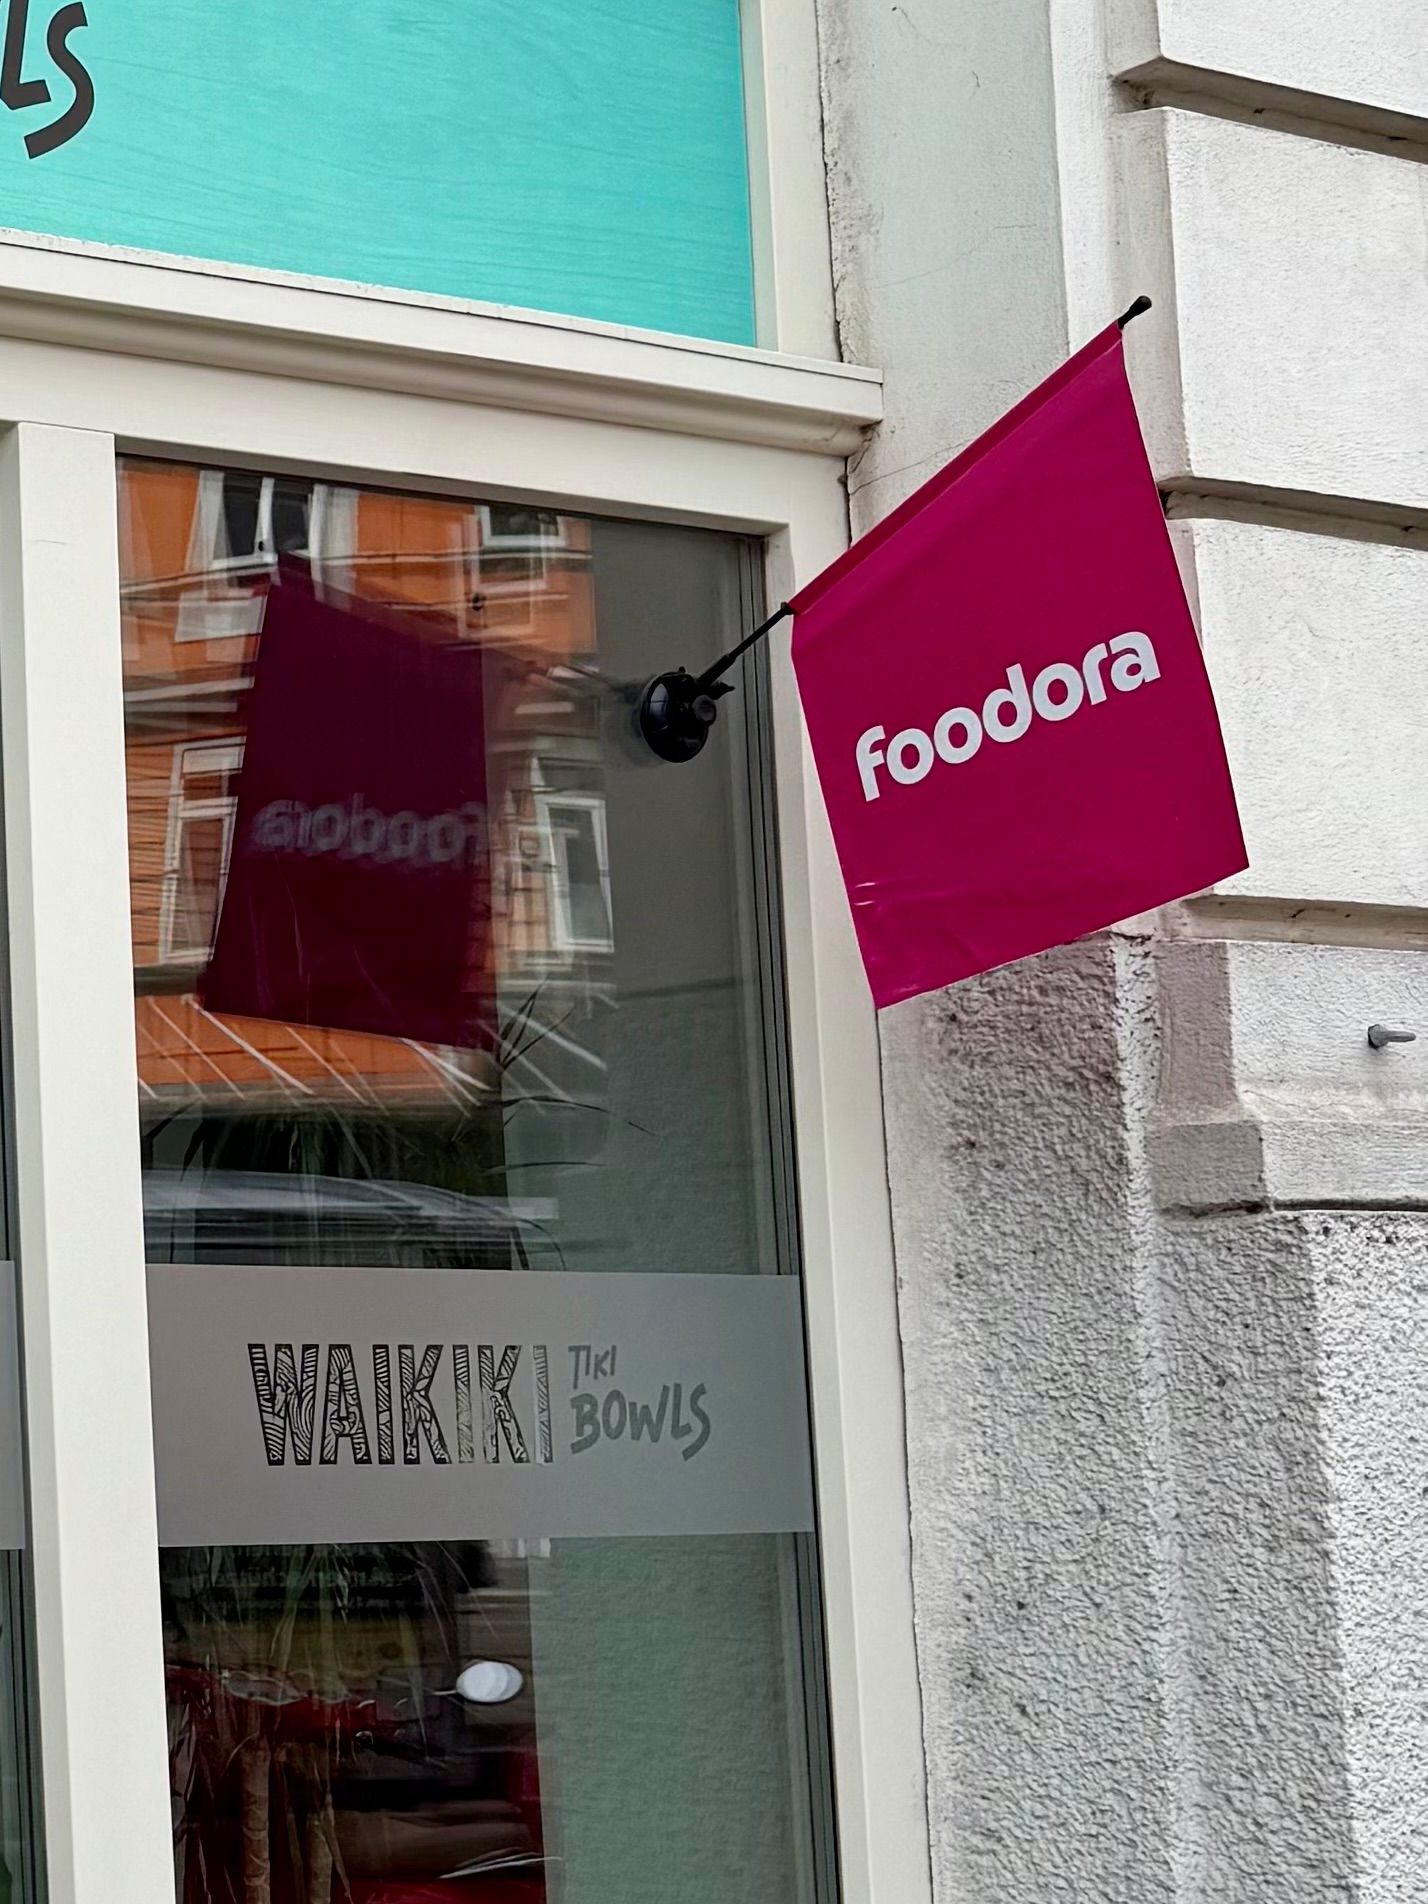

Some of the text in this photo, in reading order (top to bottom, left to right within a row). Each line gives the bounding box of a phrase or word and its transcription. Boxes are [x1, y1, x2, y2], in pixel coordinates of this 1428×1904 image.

[855, 630, 1162, 802] foodora
[247, 1343, 554, 1466] WAIKIKI
[568, 1344, 617, 1389] TIKI
[569, 1382, 711, 1462] BOWLS
